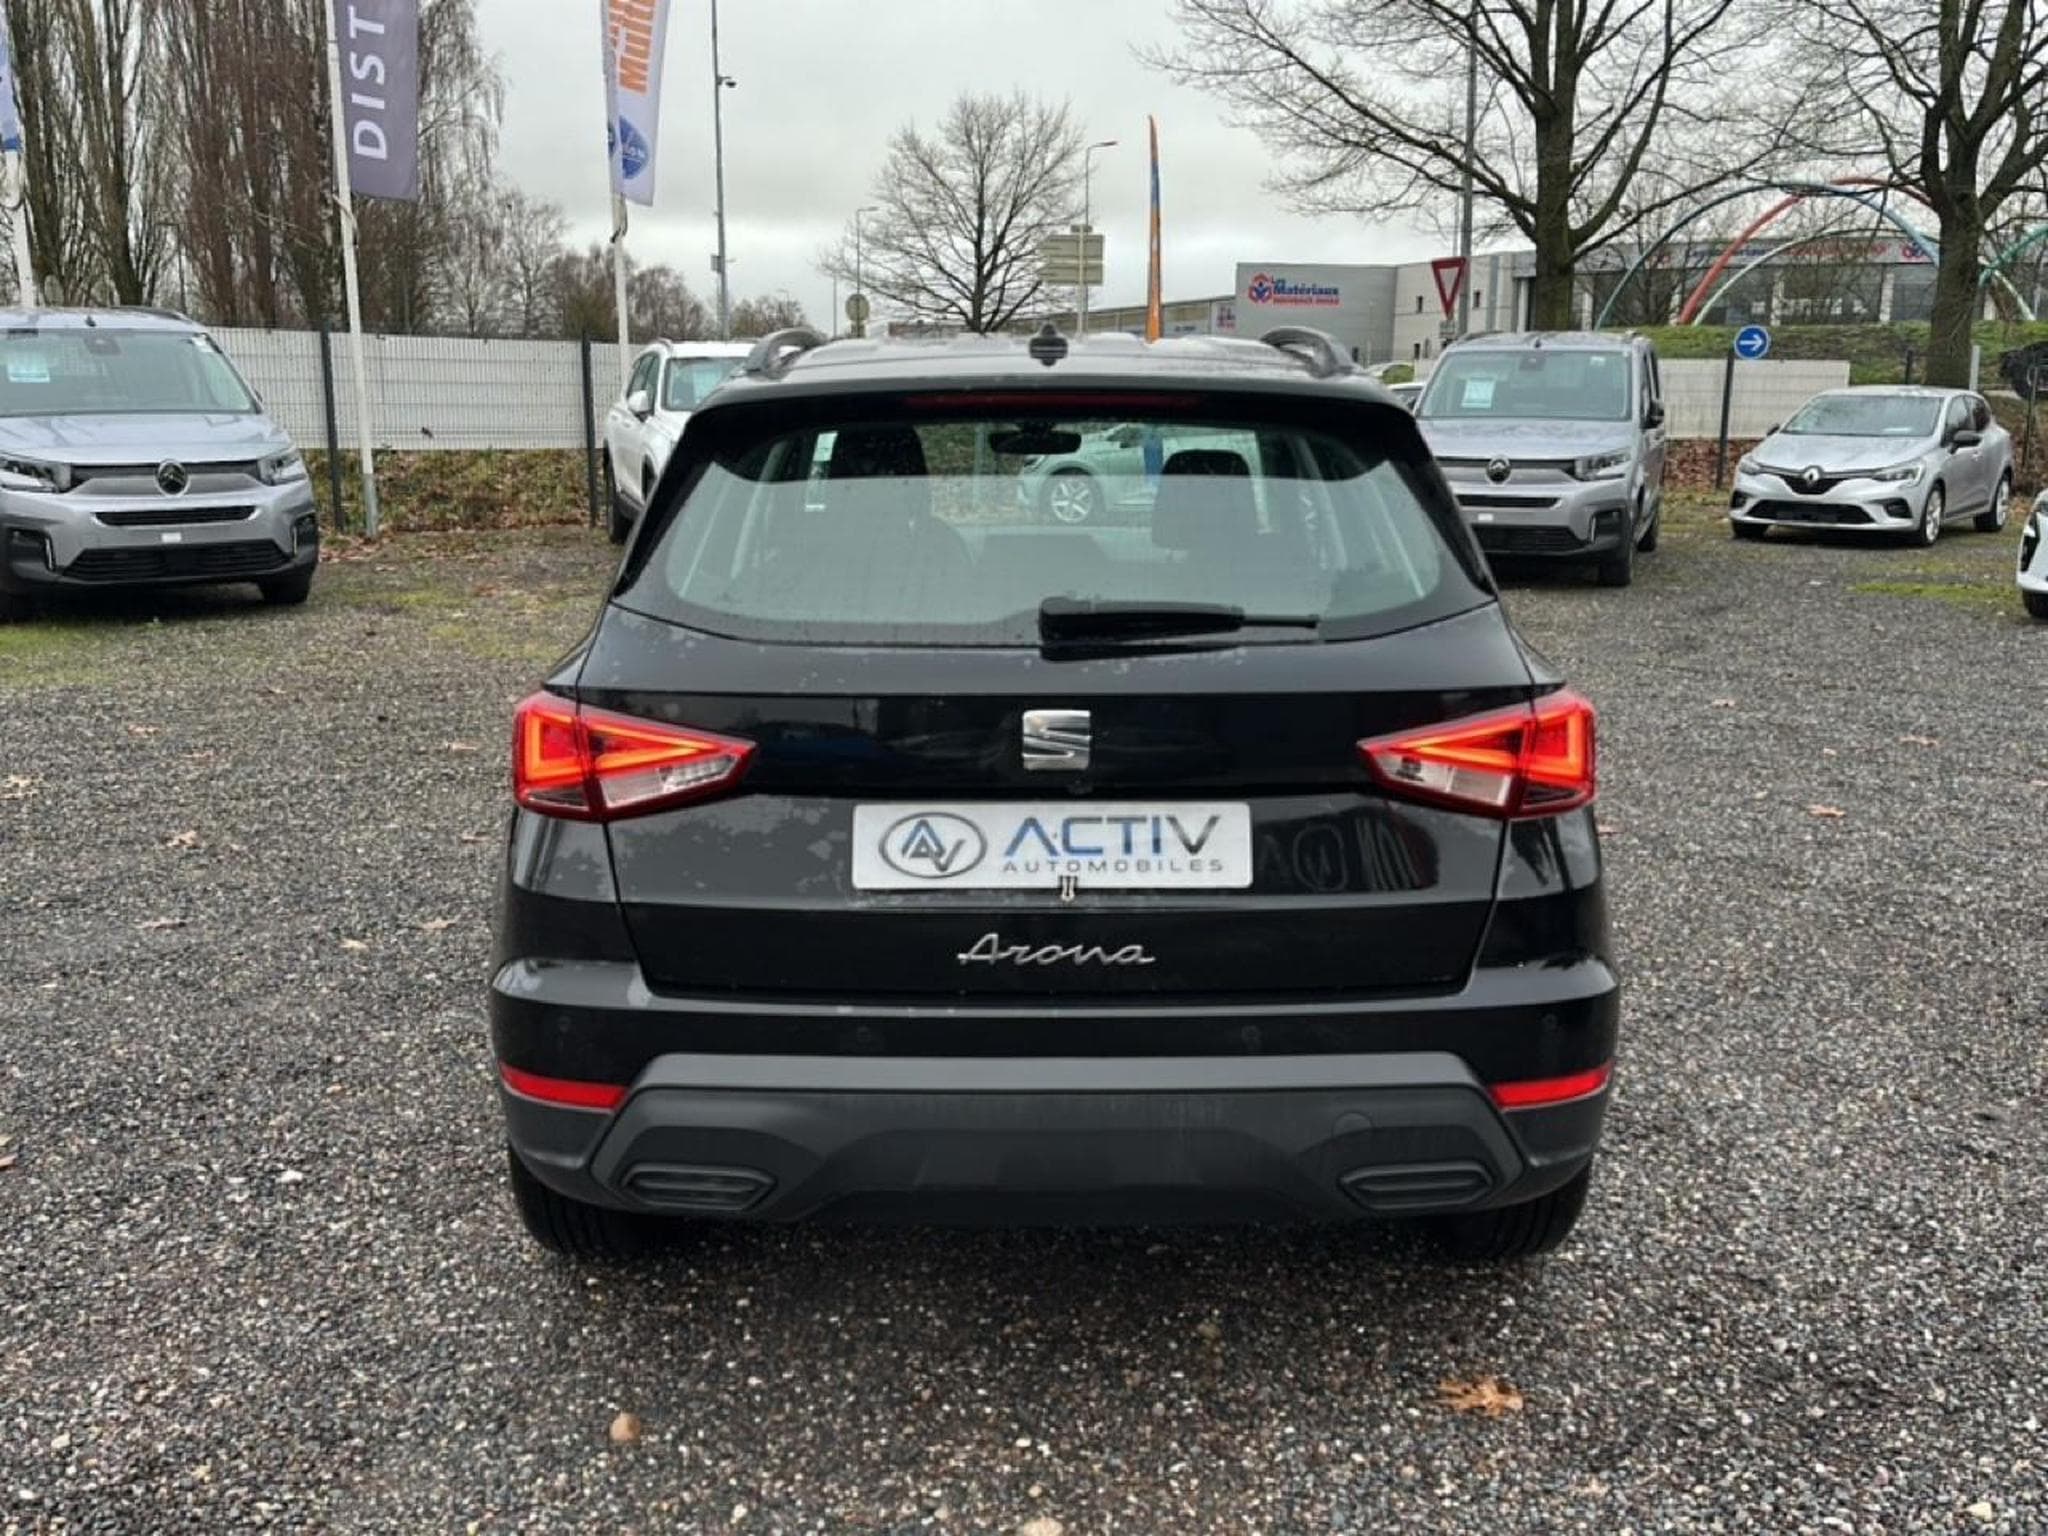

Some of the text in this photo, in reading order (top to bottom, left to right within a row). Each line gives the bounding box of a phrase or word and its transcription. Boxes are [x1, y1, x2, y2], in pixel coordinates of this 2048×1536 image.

[348, 5, 388, 160] DIST
[1004, 814, 1221, 857] ACTIV
[1004, 858, 1224, 873] AUTOMOBILES
[957, 932, 1157, 966] Arona
